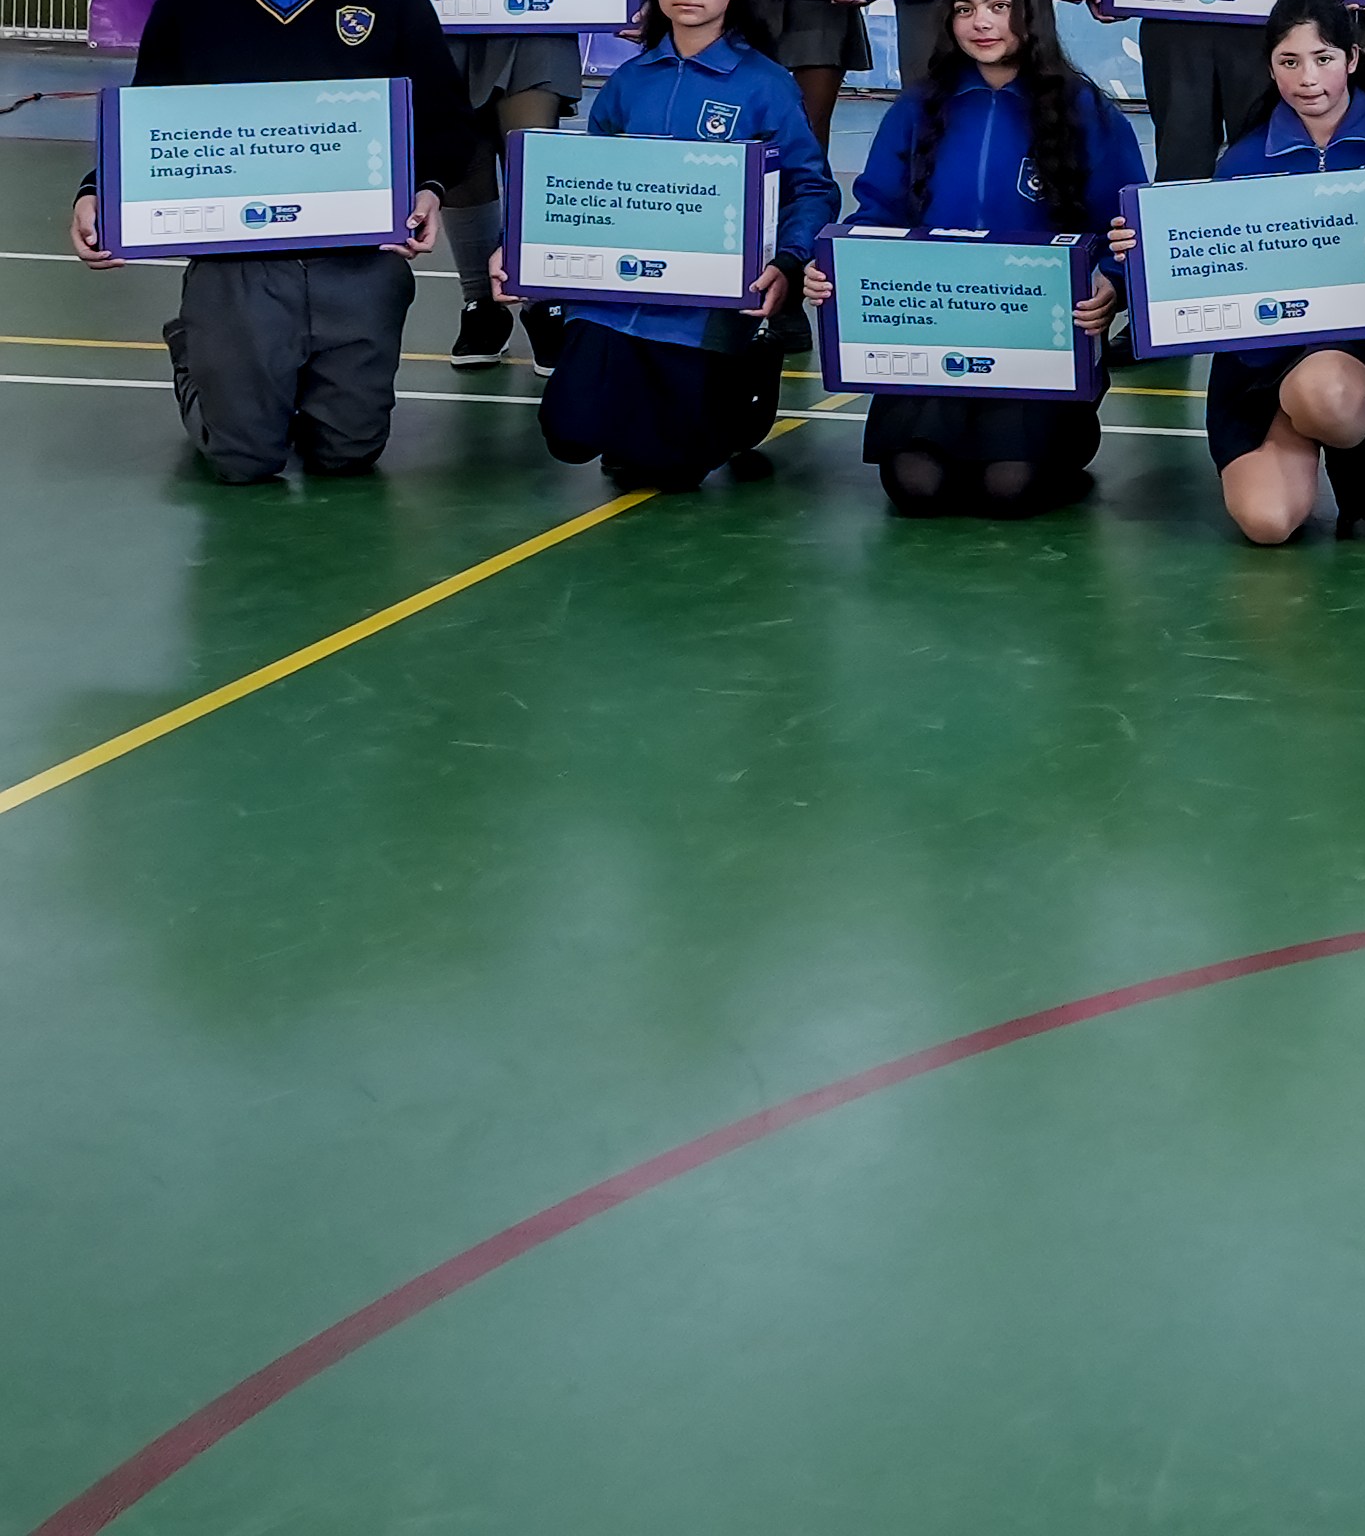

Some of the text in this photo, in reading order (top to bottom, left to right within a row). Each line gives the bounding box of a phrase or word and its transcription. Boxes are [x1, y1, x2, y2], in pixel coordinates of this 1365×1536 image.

[149, 121, 362, 142] Enciende tu creatividad.
[149, 142, 342, 160] Dale clic al futuro que
[149, 163, 237, 179] imaginas.
[545, 175, 721, 197] Enciende tu creatividad.
[545, 192, 703, 215] Dale clic al futuro que
[545, 210, 616, 227] imaginas.
[1167, 213, 1359, 242] Enciende tu creatividad.
[1169, 235, 1341, 260] Dale clic al futuro que
[1170, 261, 1248, 278] imaginas.
